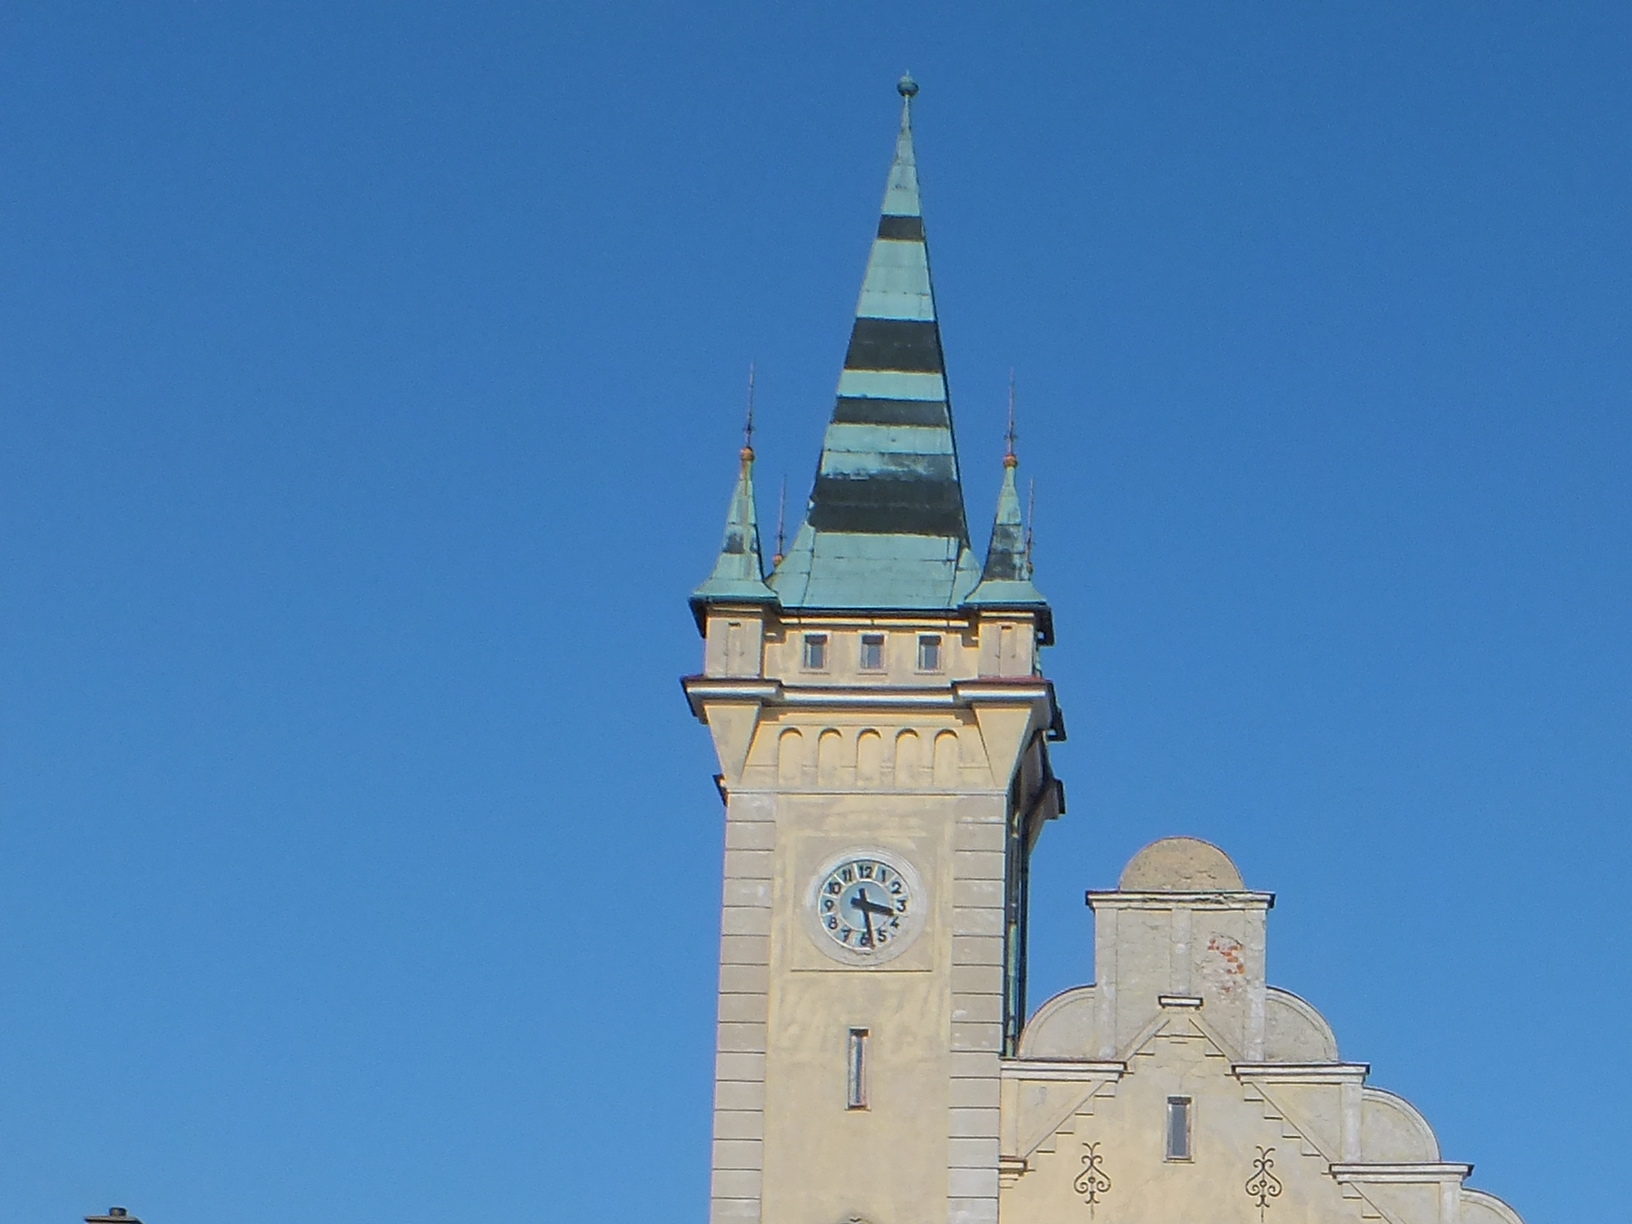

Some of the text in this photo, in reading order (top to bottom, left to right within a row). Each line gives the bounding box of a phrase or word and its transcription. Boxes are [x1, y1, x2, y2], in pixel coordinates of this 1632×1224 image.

[842, 870, 852, 882] 11
[859, 866, 873, 879] 12
[828, 881, 842, 895] 10
[891, 881, 902, 894] 2
[824, 899, 834, 912] 9
[897, 899, 907, 912] 3
[828, 917, 838, 930] 8
[890, 916, 900, 929] 4
[860, 932, 870, 946] 6
[877, 928, 887, 942] 5
